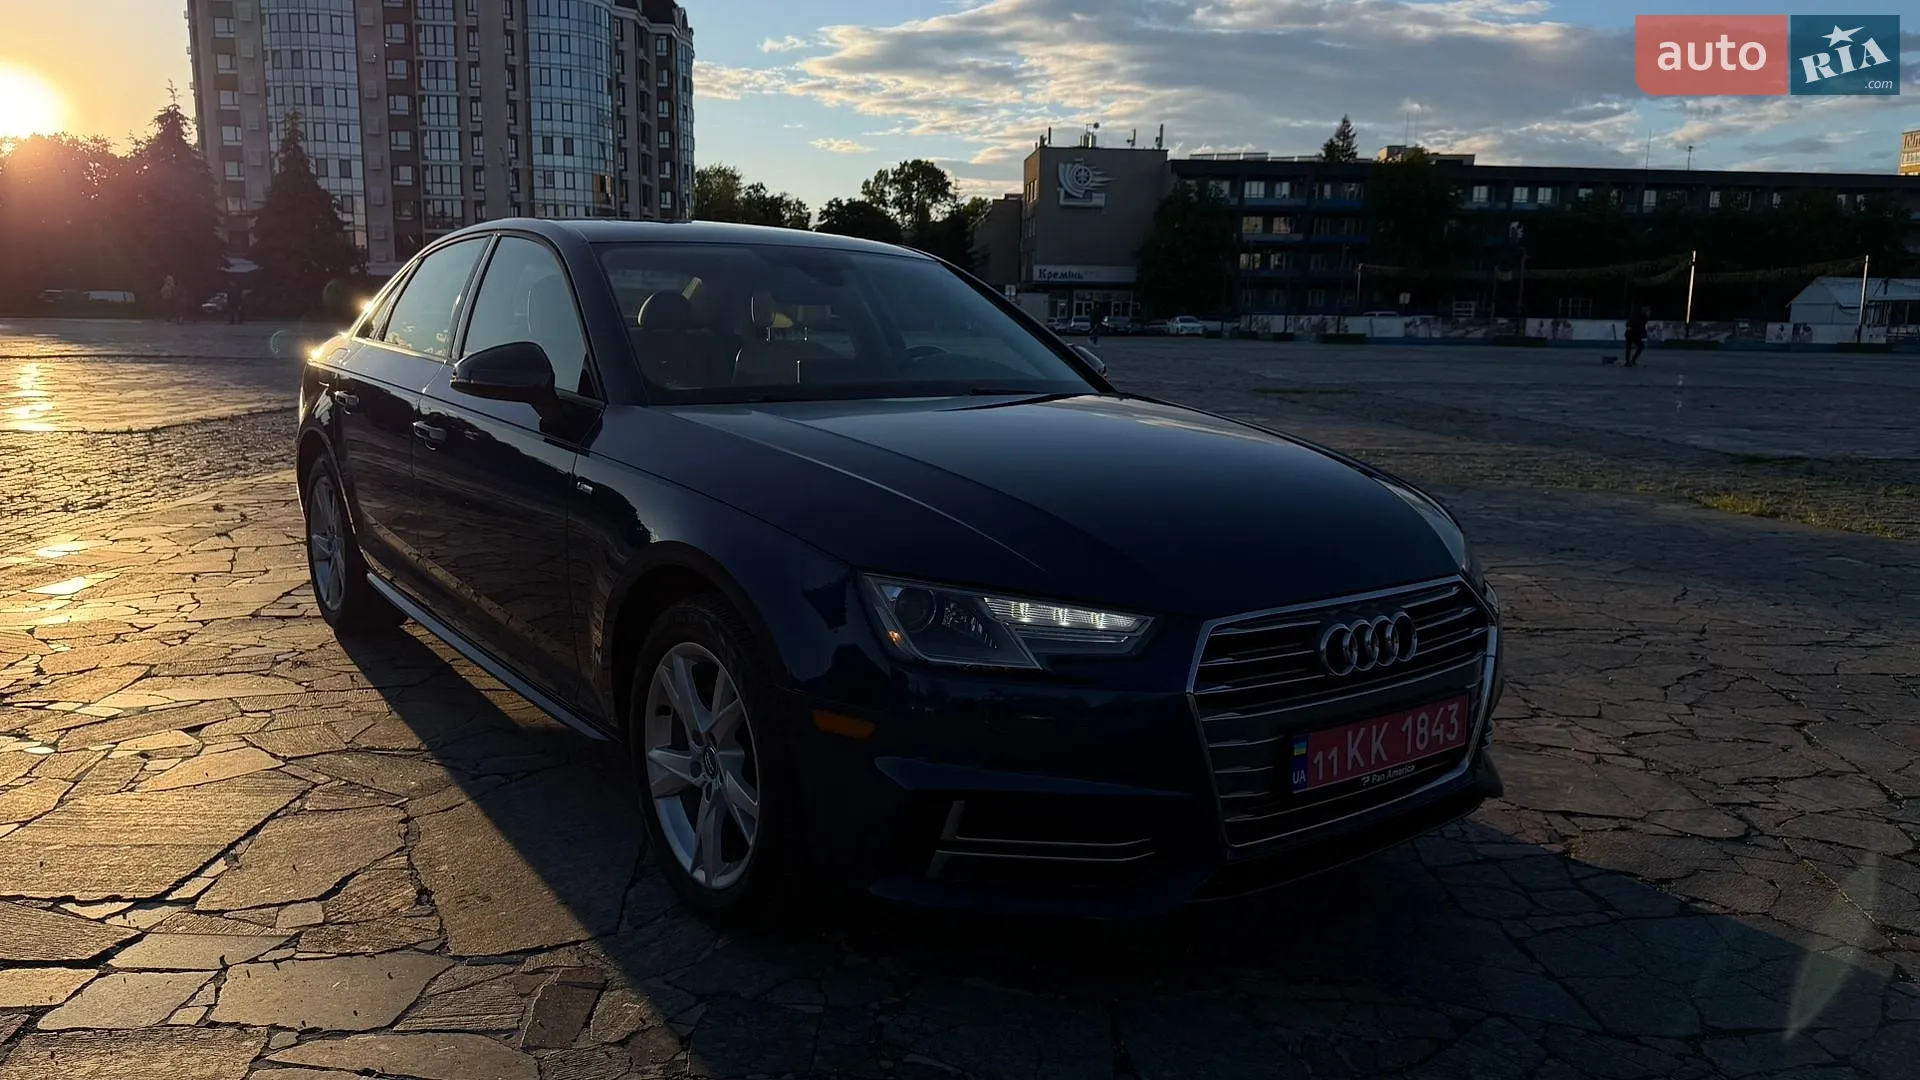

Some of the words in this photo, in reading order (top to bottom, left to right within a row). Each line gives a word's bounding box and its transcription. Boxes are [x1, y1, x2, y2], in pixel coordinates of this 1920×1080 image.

[1038, 268, 1084, 281] Кремінь
[1313, 746, 1339, 781] 11
[1347, 721, 1389, 771] KK
[1402, 702, 1461, 755] 1843
[1293, 769, 1307, 785] UA
[1386, 764, 1416, 781] America
